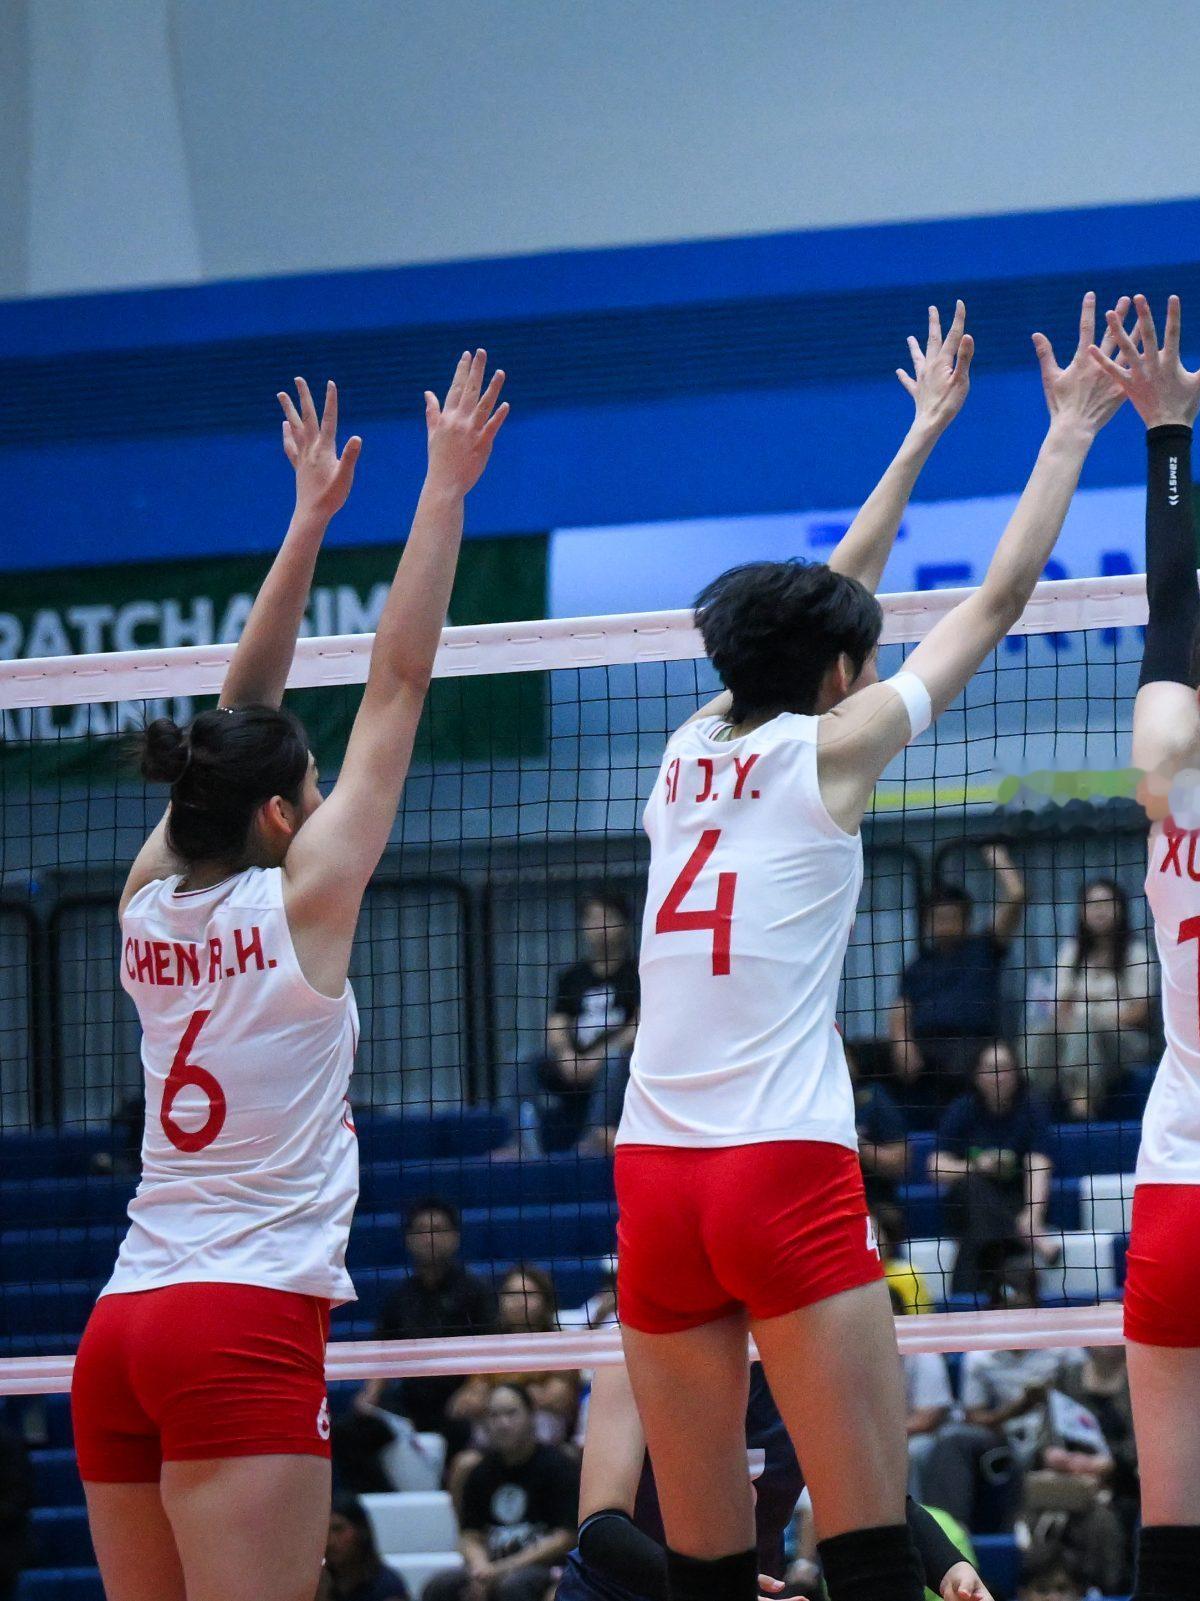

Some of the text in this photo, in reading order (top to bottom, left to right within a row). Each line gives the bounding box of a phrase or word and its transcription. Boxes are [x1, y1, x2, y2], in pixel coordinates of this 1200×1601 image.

[125, 936, 200, 987] CHEN
[656, 828, 738, 976] 4
[160, 1009, 227, 1153] 6
